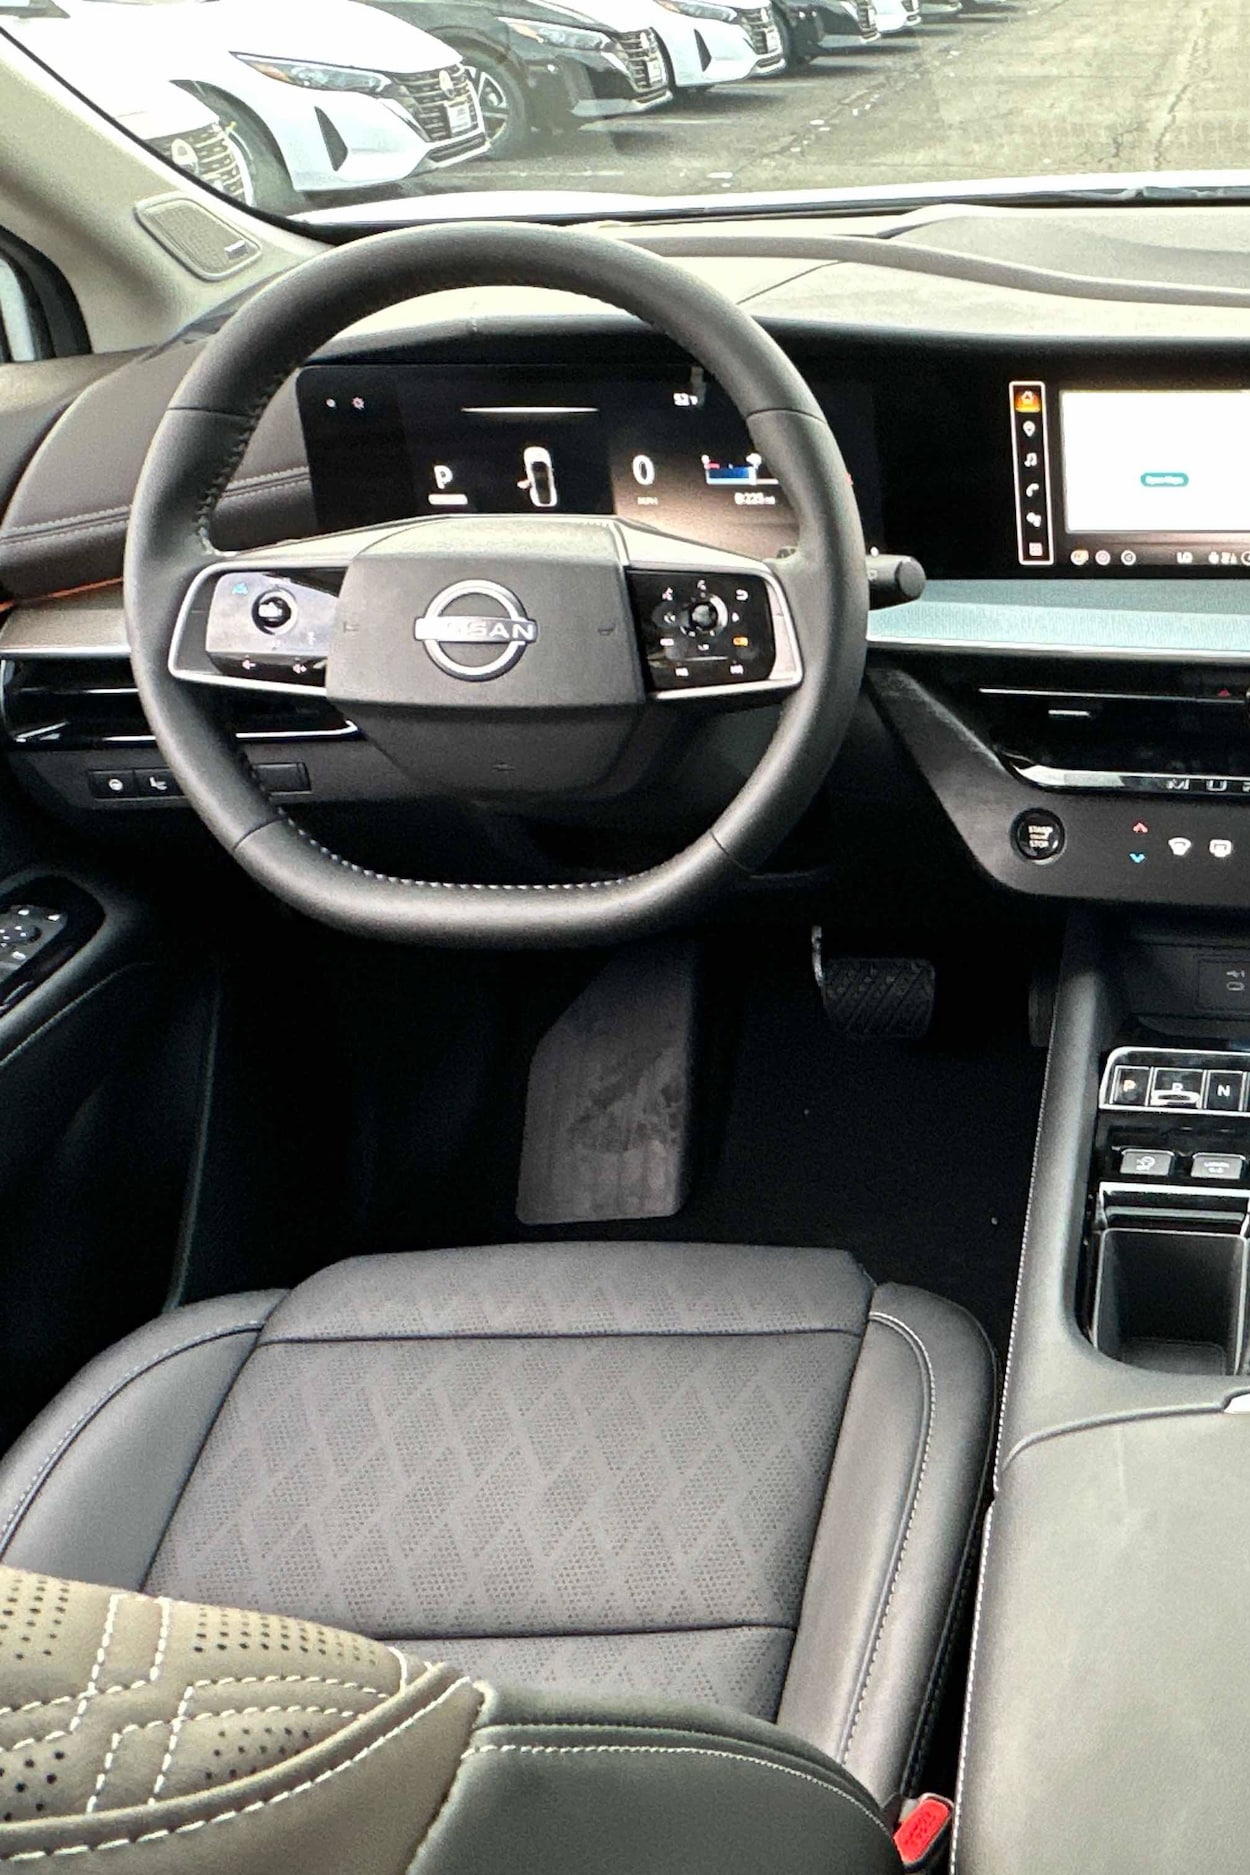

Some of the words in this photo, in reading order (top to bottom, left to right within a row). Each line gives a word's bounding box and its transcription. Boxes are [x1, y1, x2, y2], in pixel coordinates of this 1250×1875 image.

[434, 465, 453, 489] P
[633, 455, 655, 485] 0
[1123, 1079, 1137, 1092] P
[1217, 1084, 1231, 1097] N
